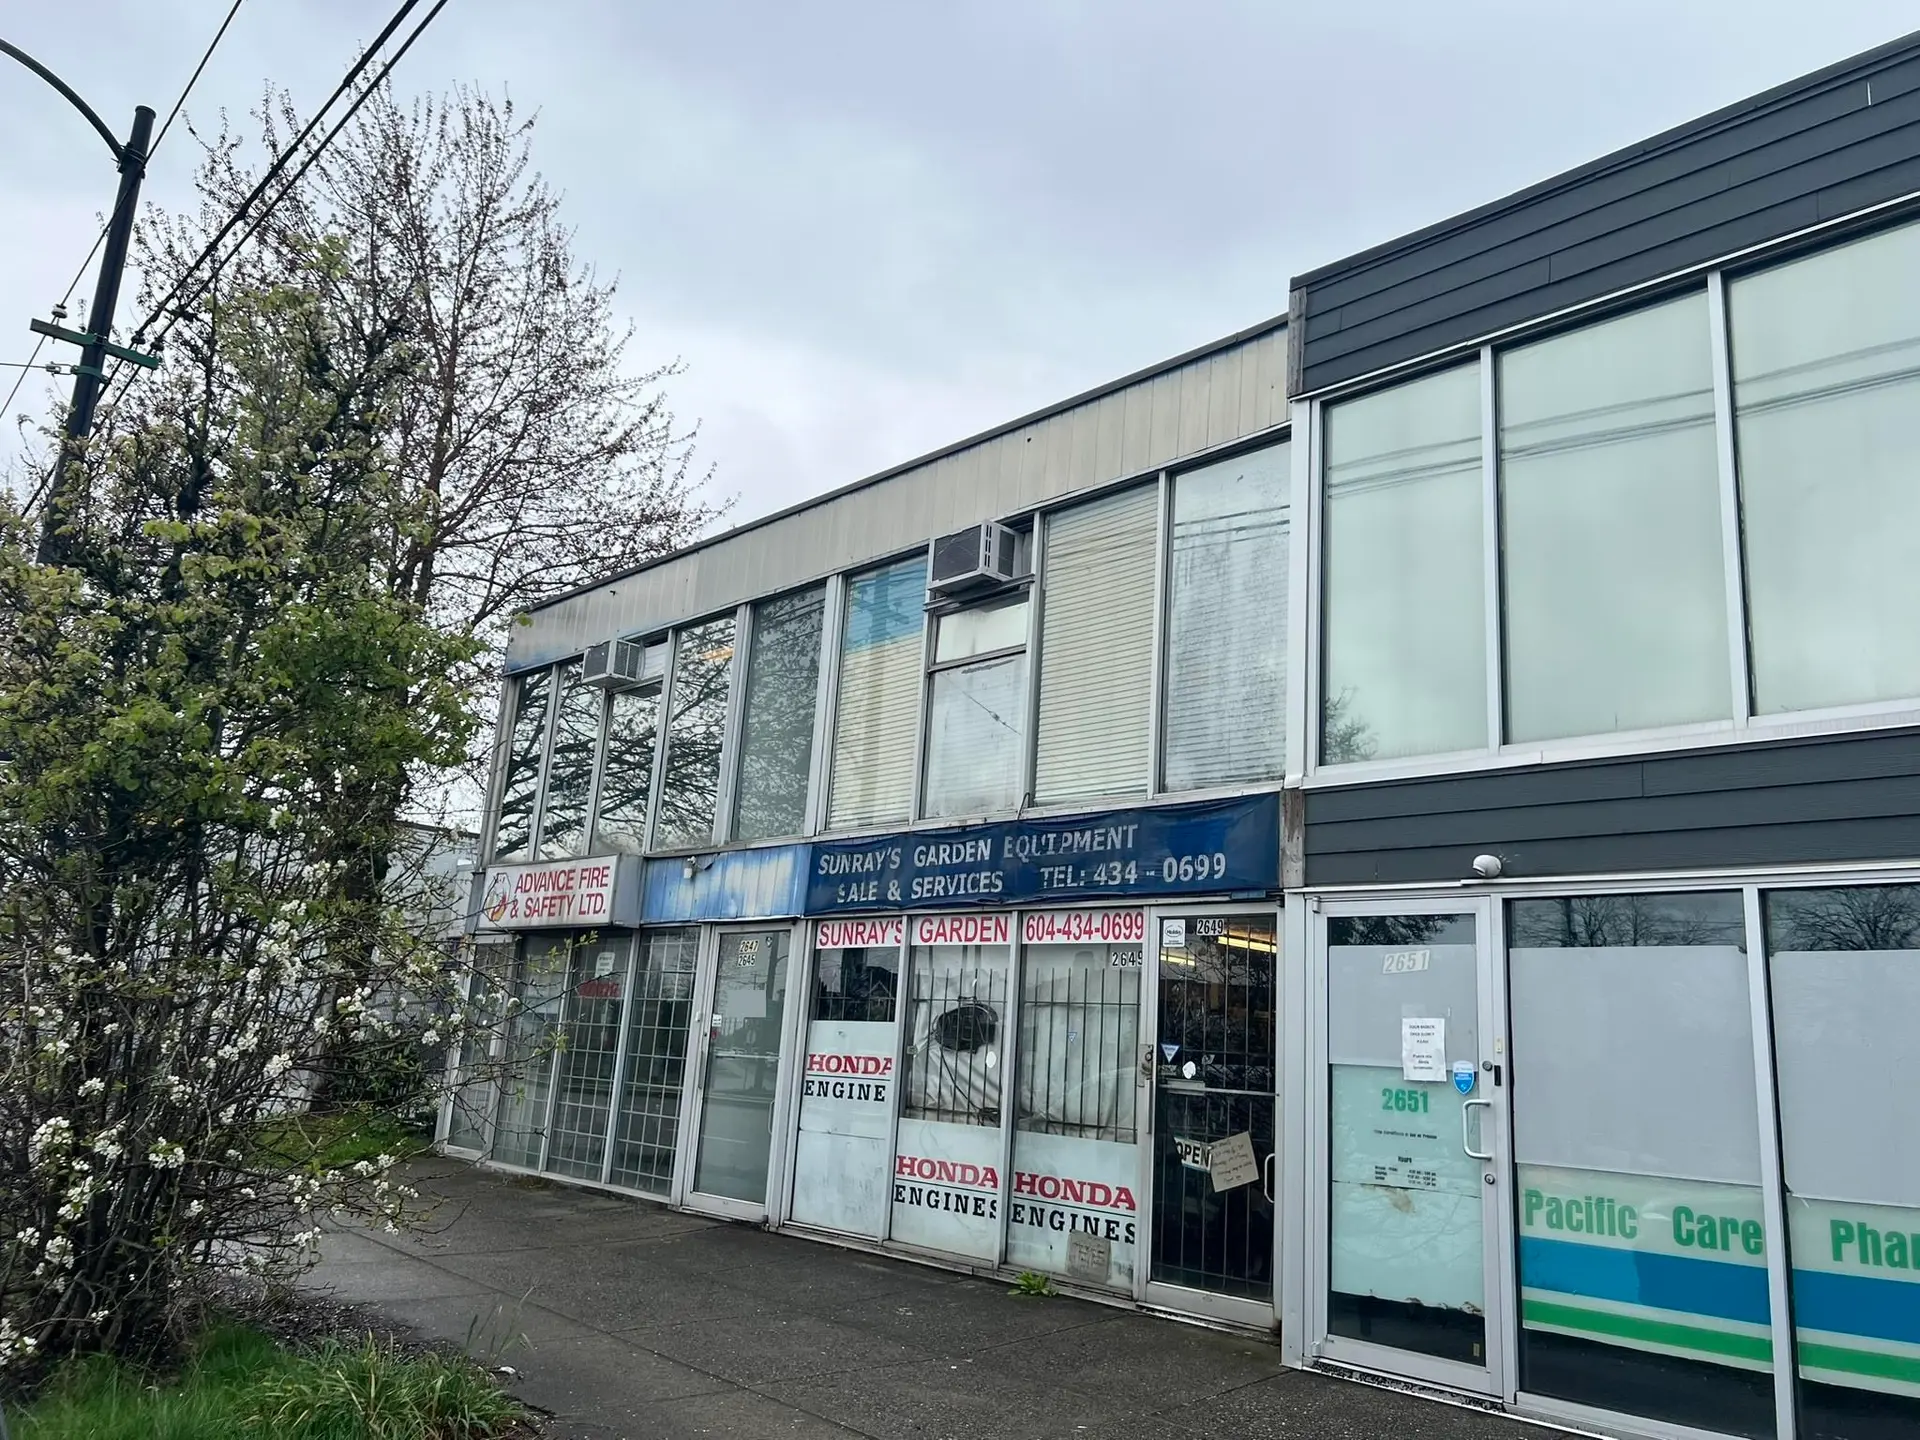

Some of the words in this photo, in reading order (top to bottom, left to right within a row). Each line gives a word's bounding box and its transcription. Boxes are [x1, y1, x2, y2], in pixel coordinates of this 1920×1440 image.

[818, 847, 901, 875] SUNRAY'S
[913, 838, 992, 868] GARDEN
[1003, 824, 1138, 863] EQUIPMENT
[514, 869, 576, 894] ADVANCE
[579, 866, 610, 889] FIRE
[837, 880, 878, 903] SALE
[887, 879, 902, 901] &
[911, 871, 1004, 899] SERVICES
[1039, 866, 1085, 890] TEL:
[510, 897, 518, 919] &
[524, 894, 576, 918] SAFETY
[578, 892, 606, 916] LTD.
[819, 919, 902, 947] SUNRAY'S
[919, 915, 1008, 943] GARDEN
[1026, 911, 1143, 942] 604-434-0699
[1197, 919, 1224, 935] 2649
[740, 940, 759, 953] 2647
[1112, 951, 1143, 967] 2649
[738, 954, 756, 967] 2645
[1384, 951, 1429, 972] 2651
[806, 1053, 892, 1076] HONDA
[804, 1080, 886, 1102] ENGINE
[1382, 1088, 1429, 1113] 2651
[1176, 1142, 1211, 1169] OPEN
[896, 1155, 998, 1189] HONDA
[894, 1184, 997, 1220] ENGINES
[1013, 1171, 1136, 1211] HONDA
[1011, 1203, 1136, 1244] ENGINES
[1525, 1189, 1637, 1239] Pacific
[1673, 1205, 1764, 1256] Care
